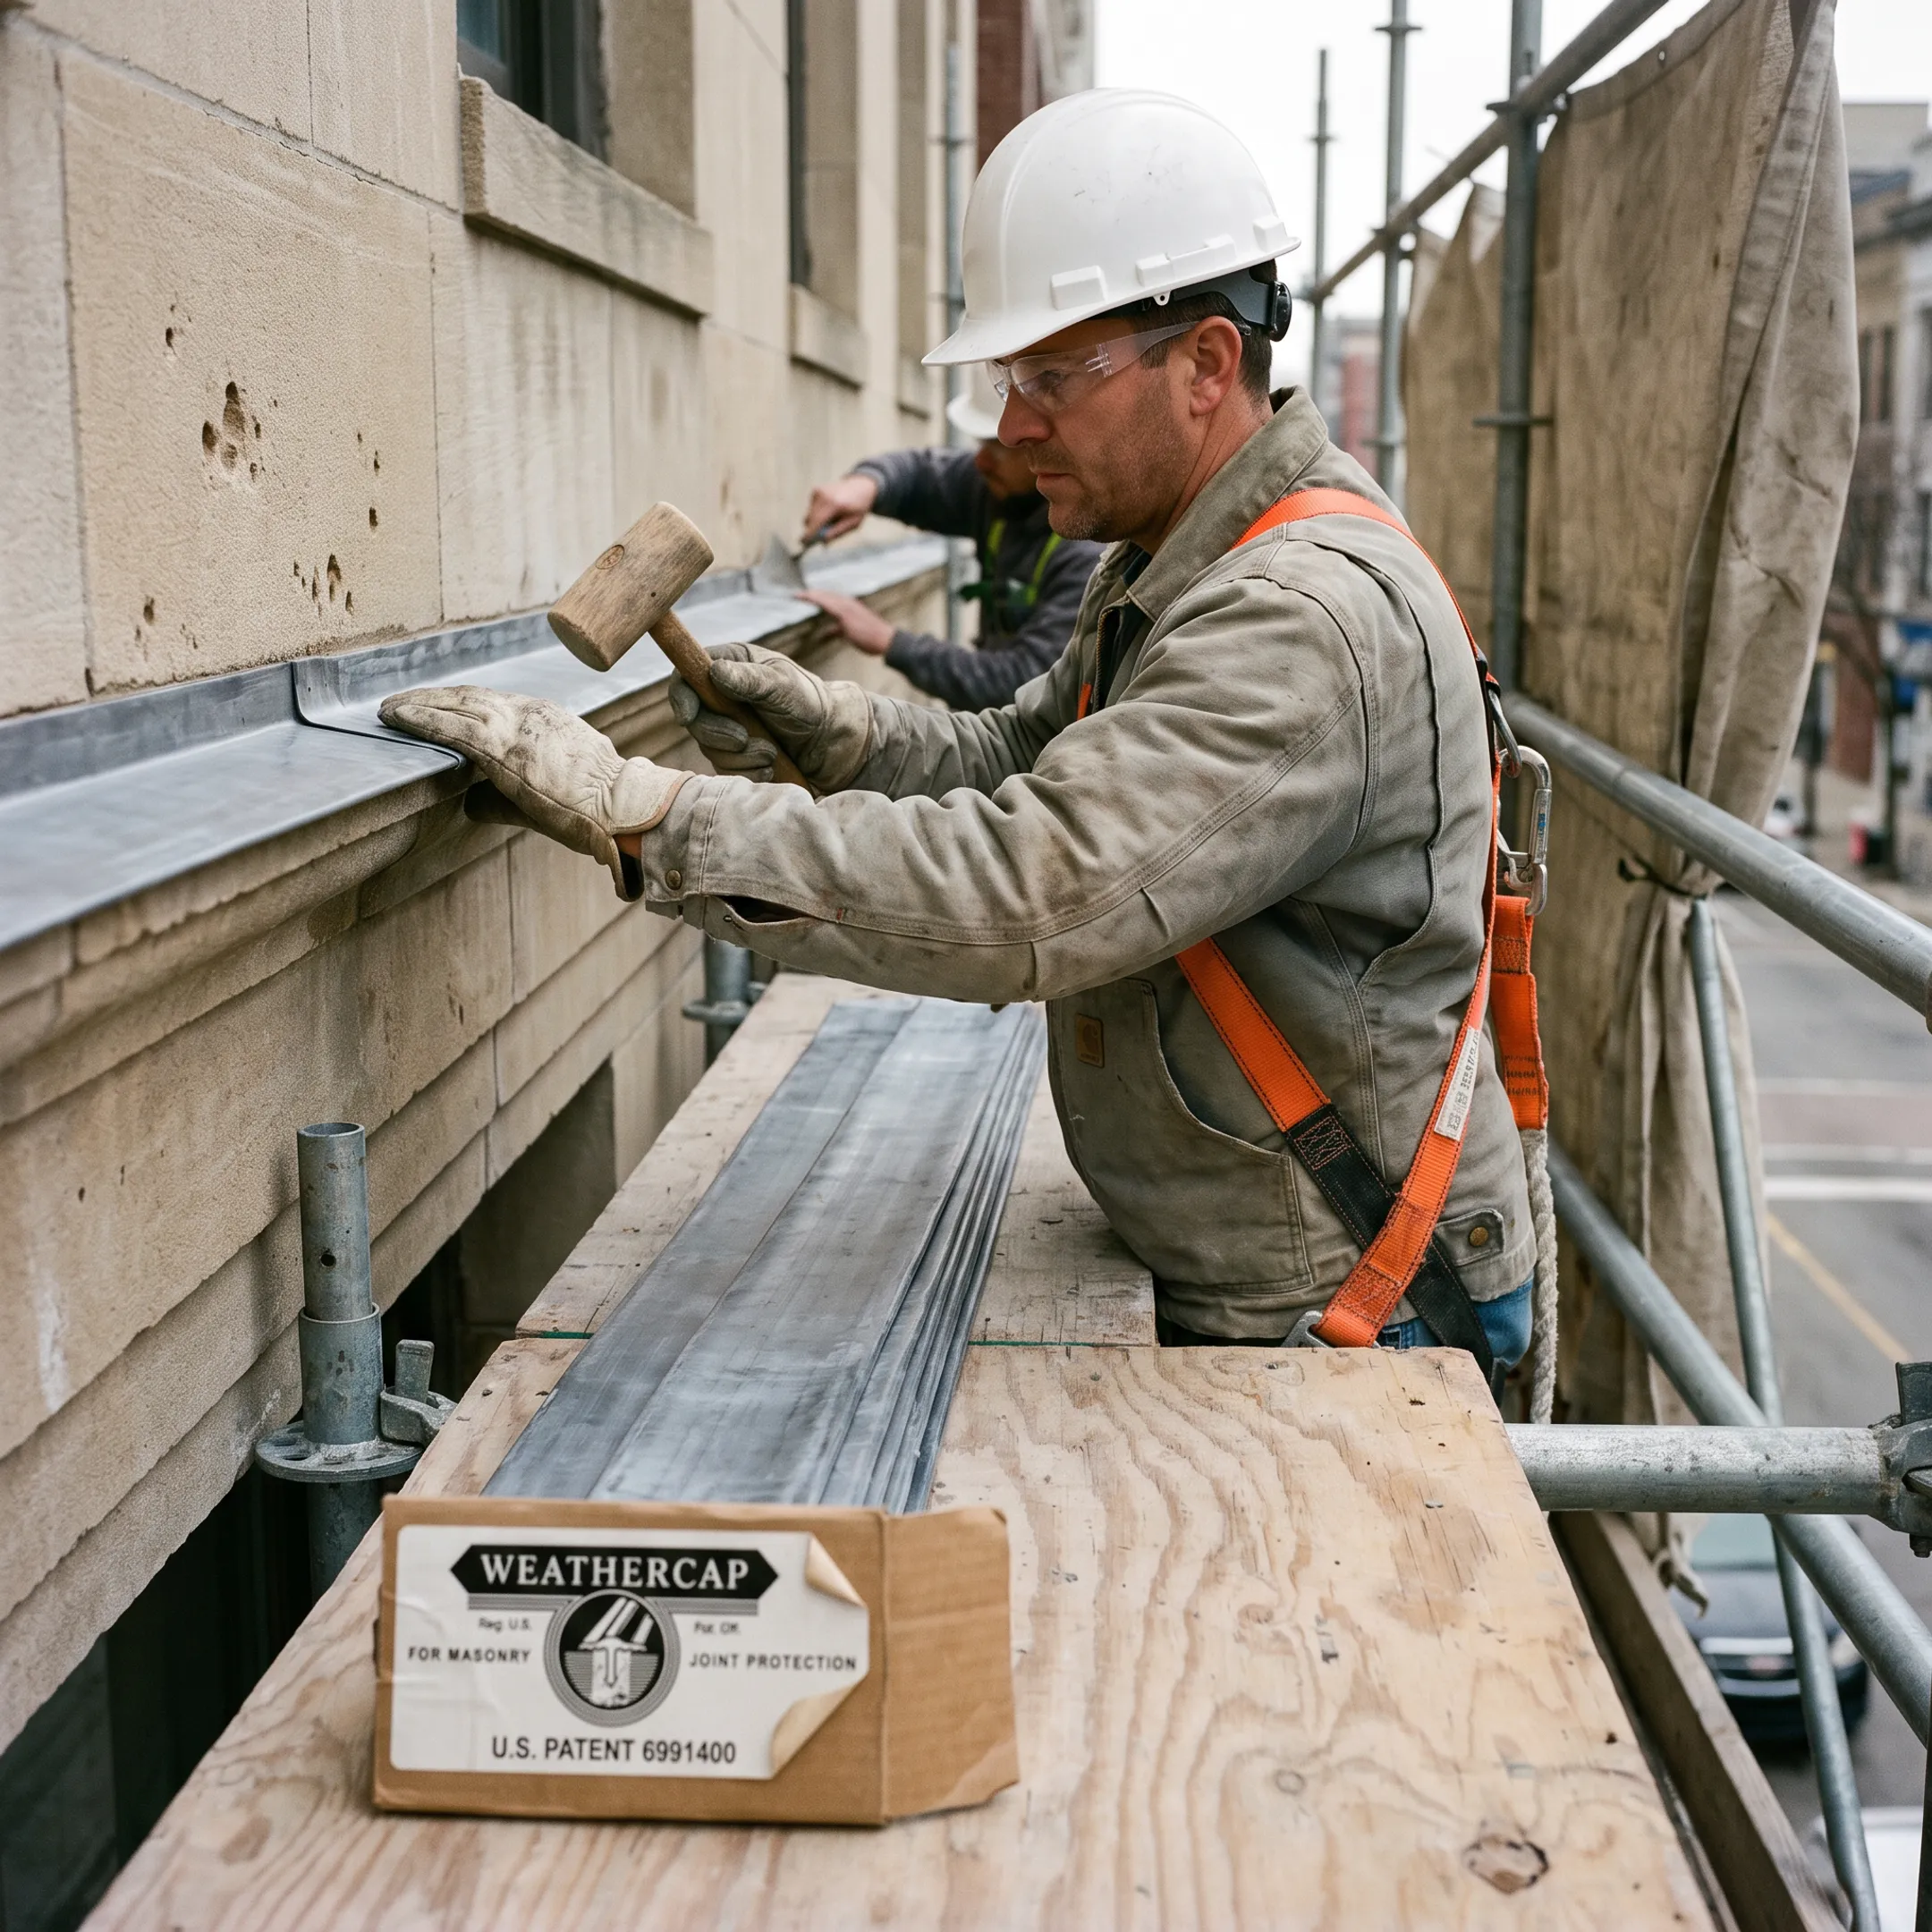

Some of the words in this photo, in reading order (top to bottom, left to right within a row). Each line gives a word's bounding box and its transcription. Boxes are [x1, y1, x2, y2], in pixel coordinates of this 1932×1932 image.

[479, 1553, 749, 1590] WEATHERCAP
[407, 1646, 441, 1662] FOR
[447, 1648, 530, 1664] MASONRY
[689, 1652, 740, 1669] JOINT
[745, 1654, 857, 1672] PROTECTION
[491, 1735, 537, 1760] U.S.
[544, 1736, 636, 1763] PATENT
[641, 1739, 737, 1765] 6991400
